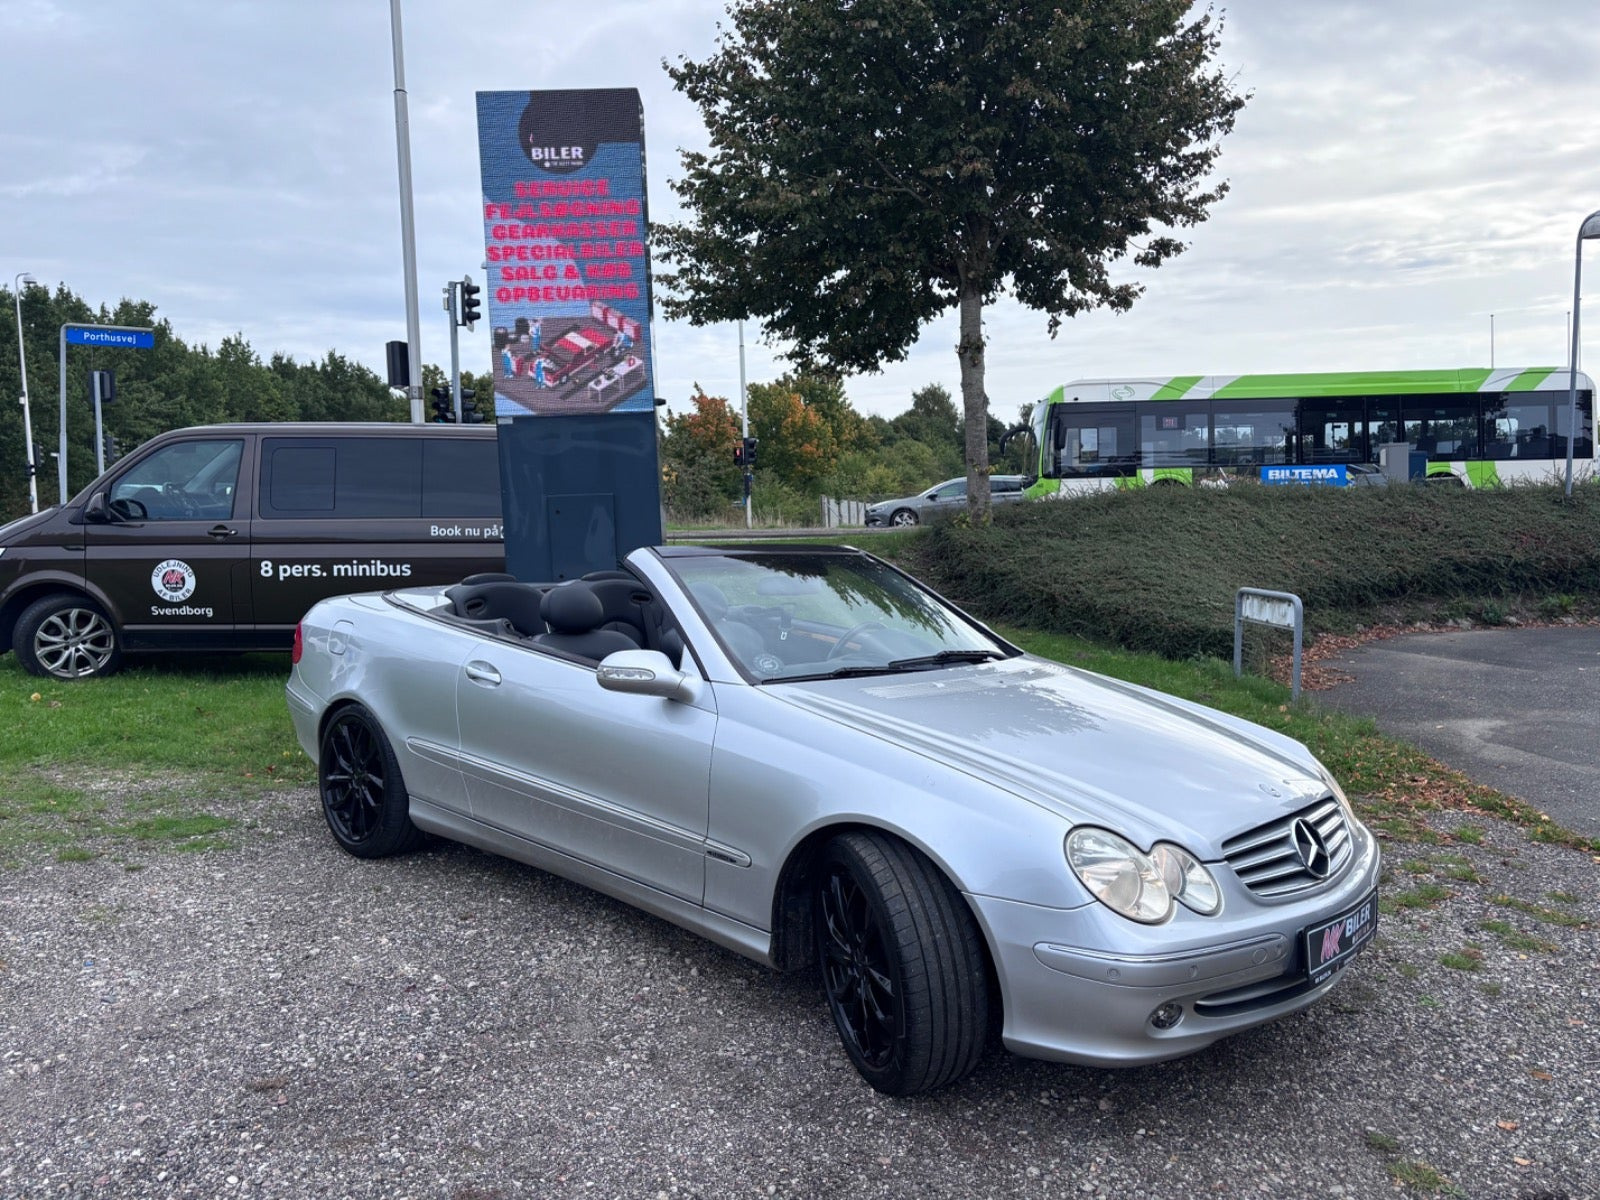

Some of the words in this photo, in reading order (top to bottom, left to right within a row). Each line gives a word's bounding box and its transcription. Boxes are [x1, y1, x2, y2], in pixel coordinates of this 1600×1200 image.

[531, 146, 583, 160] BILER
[514, 179, 609, 198] SERVICE
[501, 264, 557, 282] SALG
[563, 263, 580, 281] &
[496, 282, 640, 303] OPBEVARING
[83, 332, 136, 344] Porthusvej
[1268, 468, 1338, 480] BILTEMA
[430, 525, 461, 536] Book
[465, 528, 480, 536] nu
[484, 524, 499, 539] på
[153, 561, 193, 578] UDLEJNING
[260, 560, 273, 577] 8
[279, 564, 327, 581] pers.
[333, 560, 411, 577] minibus
[157, 589, 168, 597] AF
[169, 588, 192, 601] BILER
[151, 605, 213, 618] Svendborg
[1345, 903, 1371, 938] BILER
